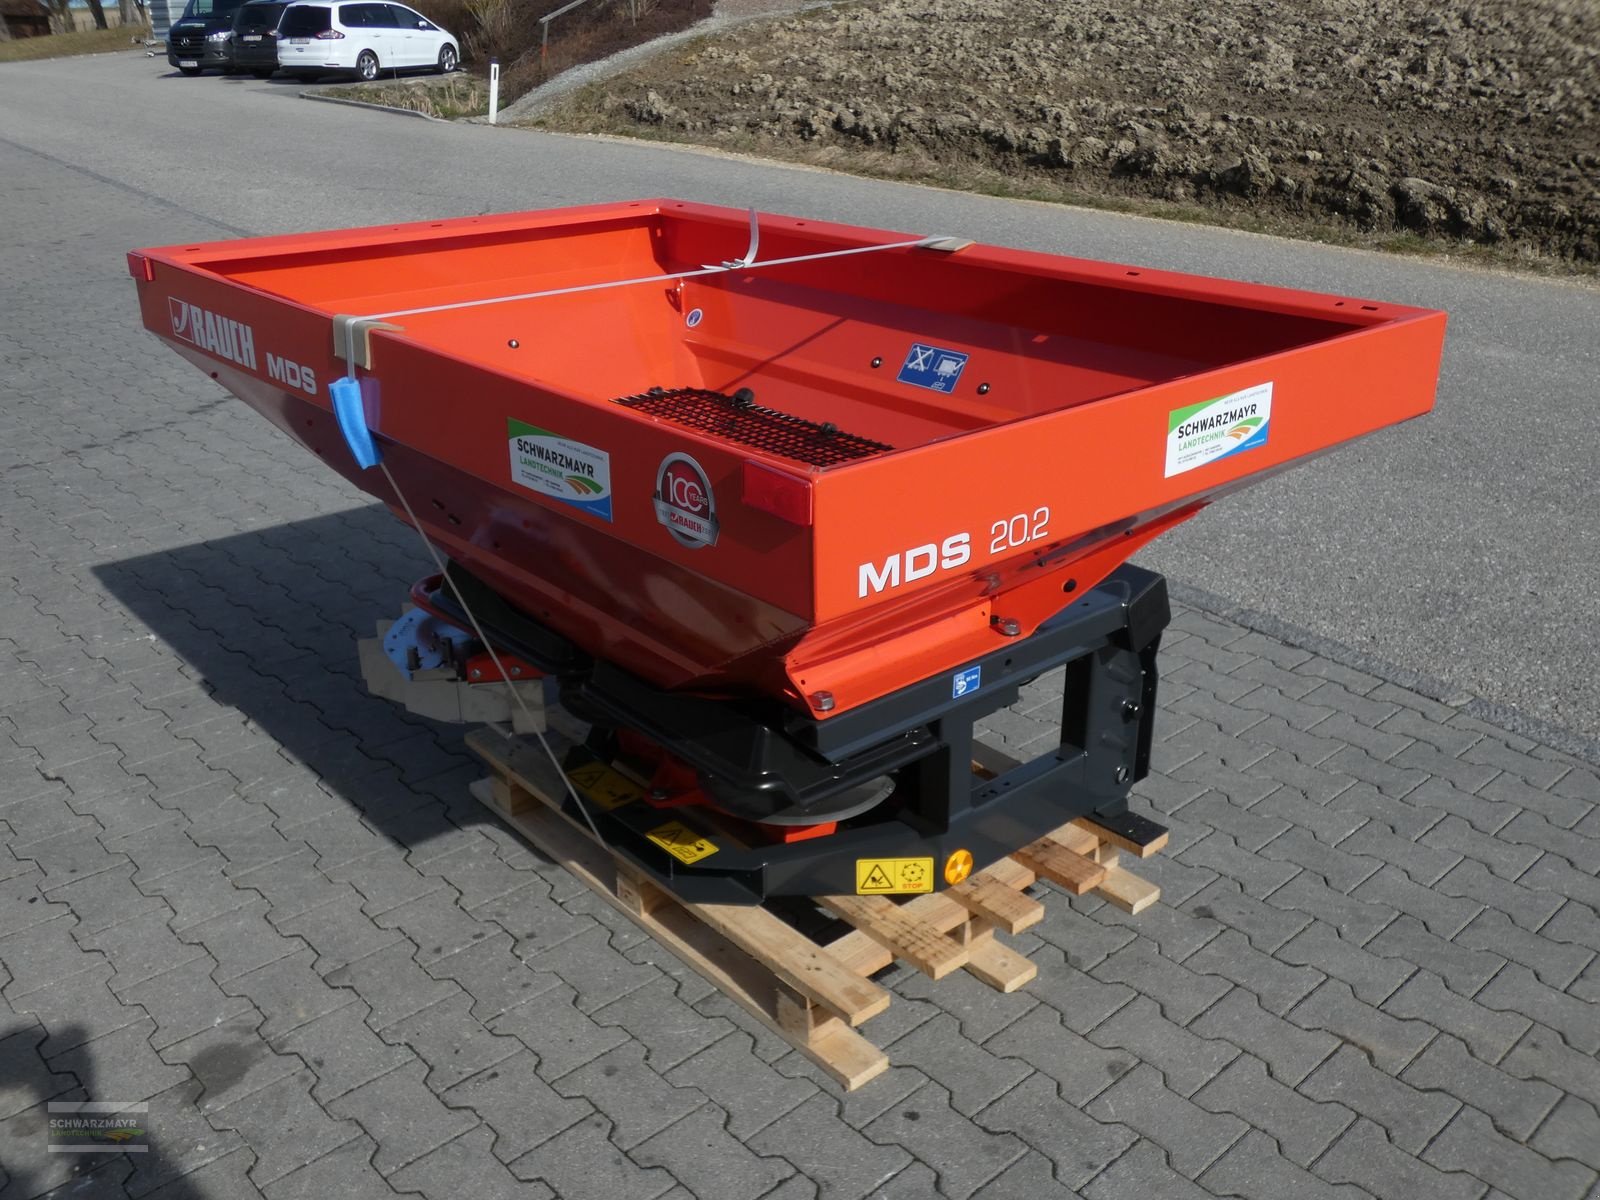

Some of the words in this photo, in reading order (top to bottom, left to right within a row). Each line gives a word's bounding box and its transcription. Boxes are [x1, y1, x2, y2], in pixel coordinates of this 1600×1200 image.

[189, 304, 257, 371] RAUCH
[266, 352, 317, 395] MDS
[1178, 403, 1257, 439] SCHWARZMAYR
[517, 438, 594, 478] SCHWARZMAYR
[1178, 429, 1226, 452] LANDTECHNIK
[520, 455, 564, 479] LANDTECHNIK
[667, 472, 703, 512] 100
[689, 492, 708, 506] YEARS
[677, 514, 704, 534] RAUCH
[858, 532, 971, 598] MDS
[990, 506, 1050, 555] 20.2
